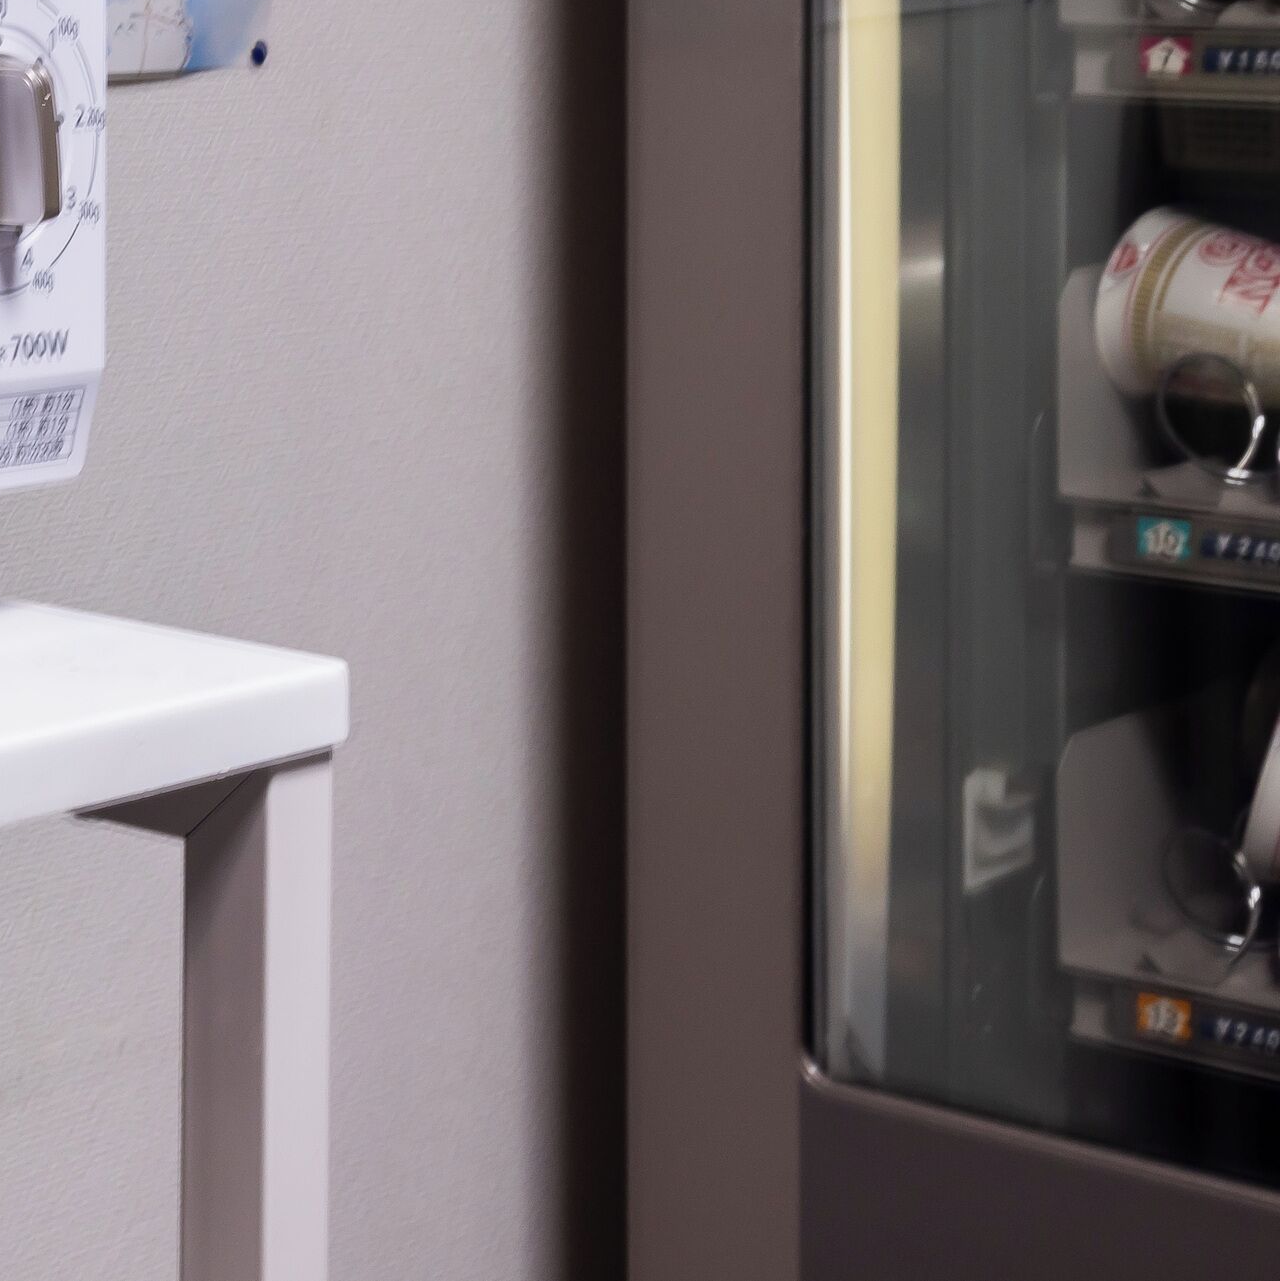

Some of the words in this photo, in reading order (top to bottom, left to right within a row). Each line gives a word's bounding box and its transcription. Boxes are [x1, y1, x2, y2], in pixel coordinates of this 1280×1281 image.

[66, 185, 77, 210] 3
[21, 248, 33, 269] 4
[11, 329, 70, 361] 700W
